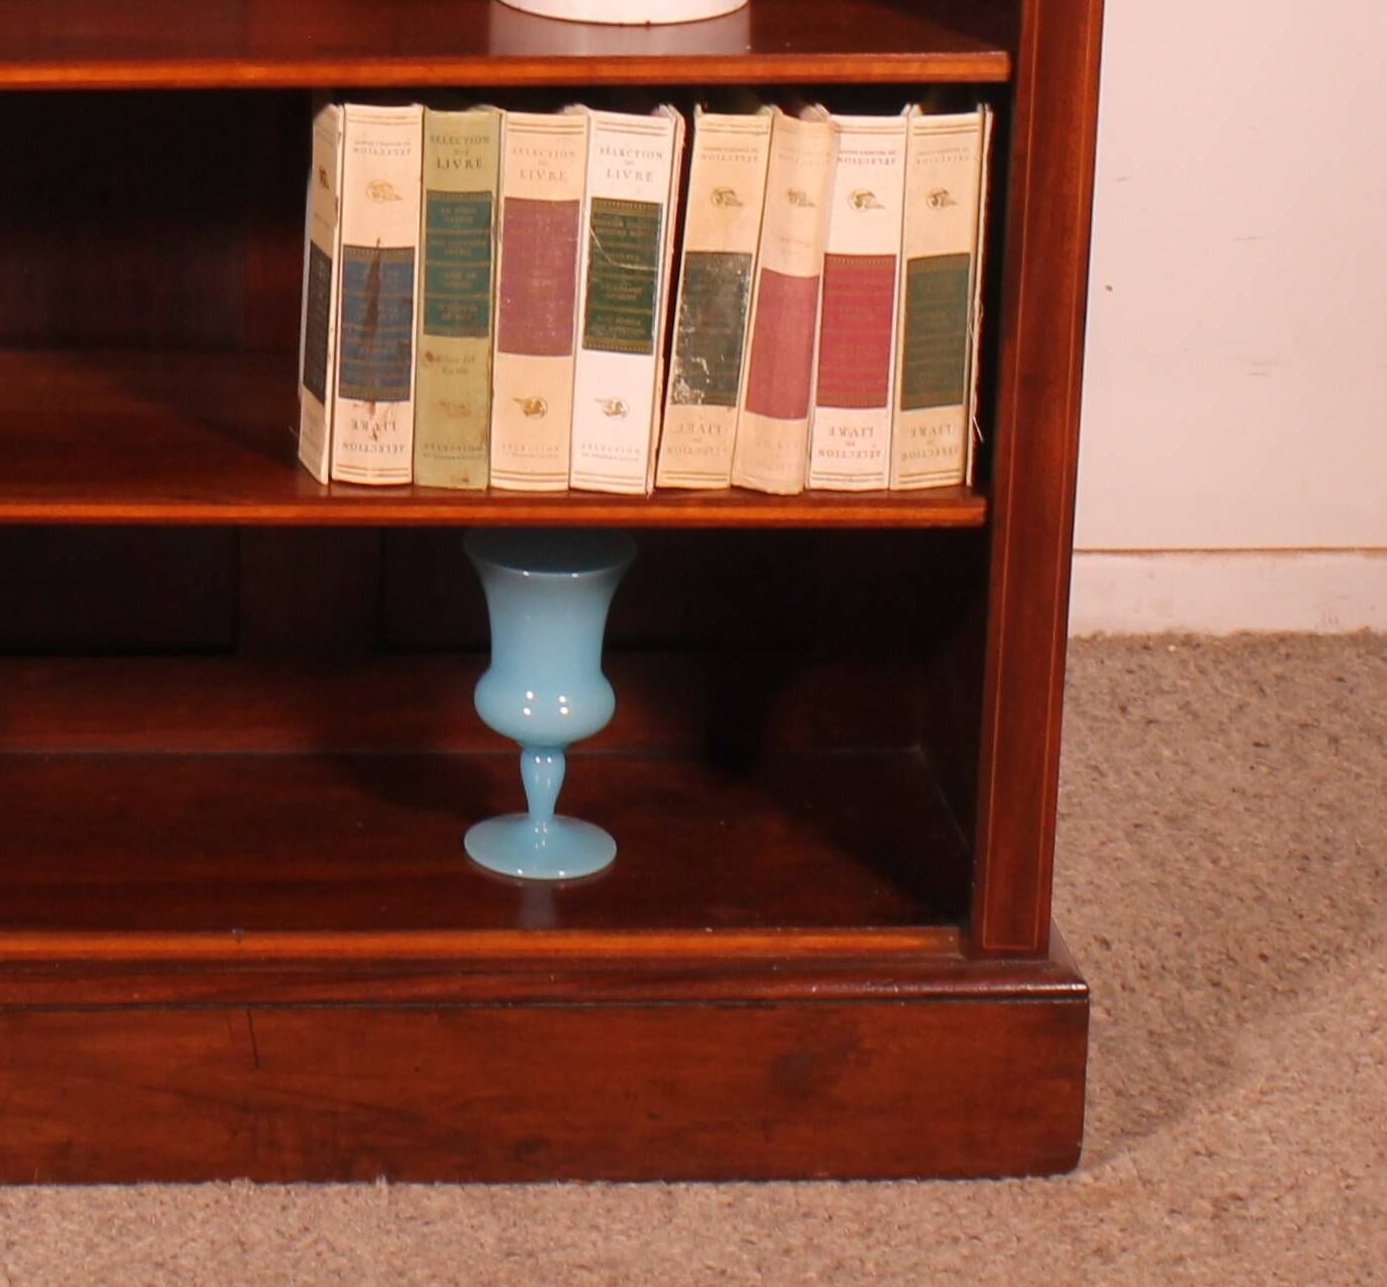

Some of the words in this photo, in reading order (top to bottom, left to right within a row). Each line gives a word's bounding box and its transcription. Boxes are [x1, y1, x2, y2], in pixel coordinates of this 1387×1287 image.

[436, 157, 484, 171] LIVRE
[520, 169, 567, 182] LIVRE
[607, 169, 654, 183] LIVRE
[827, 426, 874, 437] LIVRE
